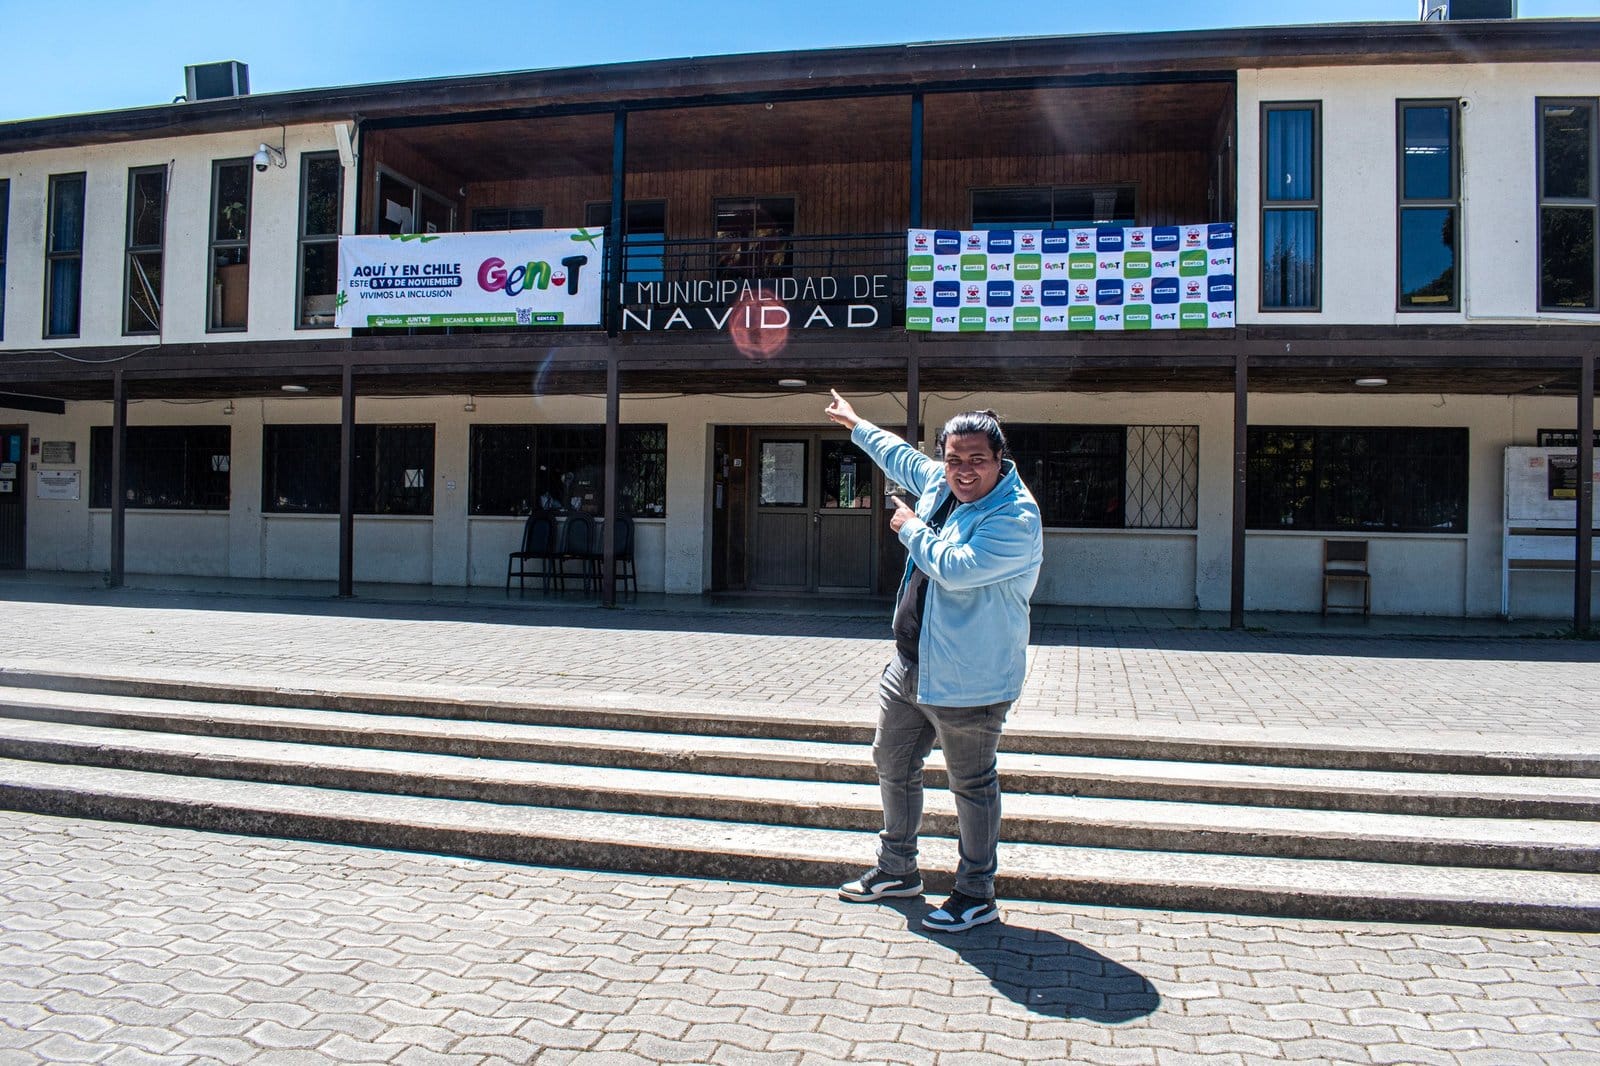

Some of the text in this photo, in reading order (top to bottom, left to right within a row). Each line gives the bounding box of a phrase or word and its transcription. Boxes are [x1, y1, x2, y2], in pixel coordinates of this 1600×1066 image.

[354, 263, 460, 276] AQUÍ Y EN CHILE
[372, 280, 378, 288] 8
[408, 278, 458, 286] NOVIEMBRE
[620, 274, 888, 304] I MUNICIPALIDAD DE
[408, 288, 452, 298] INCLUSIÓN
[622, 304, 879, 330] NAVIDAD
